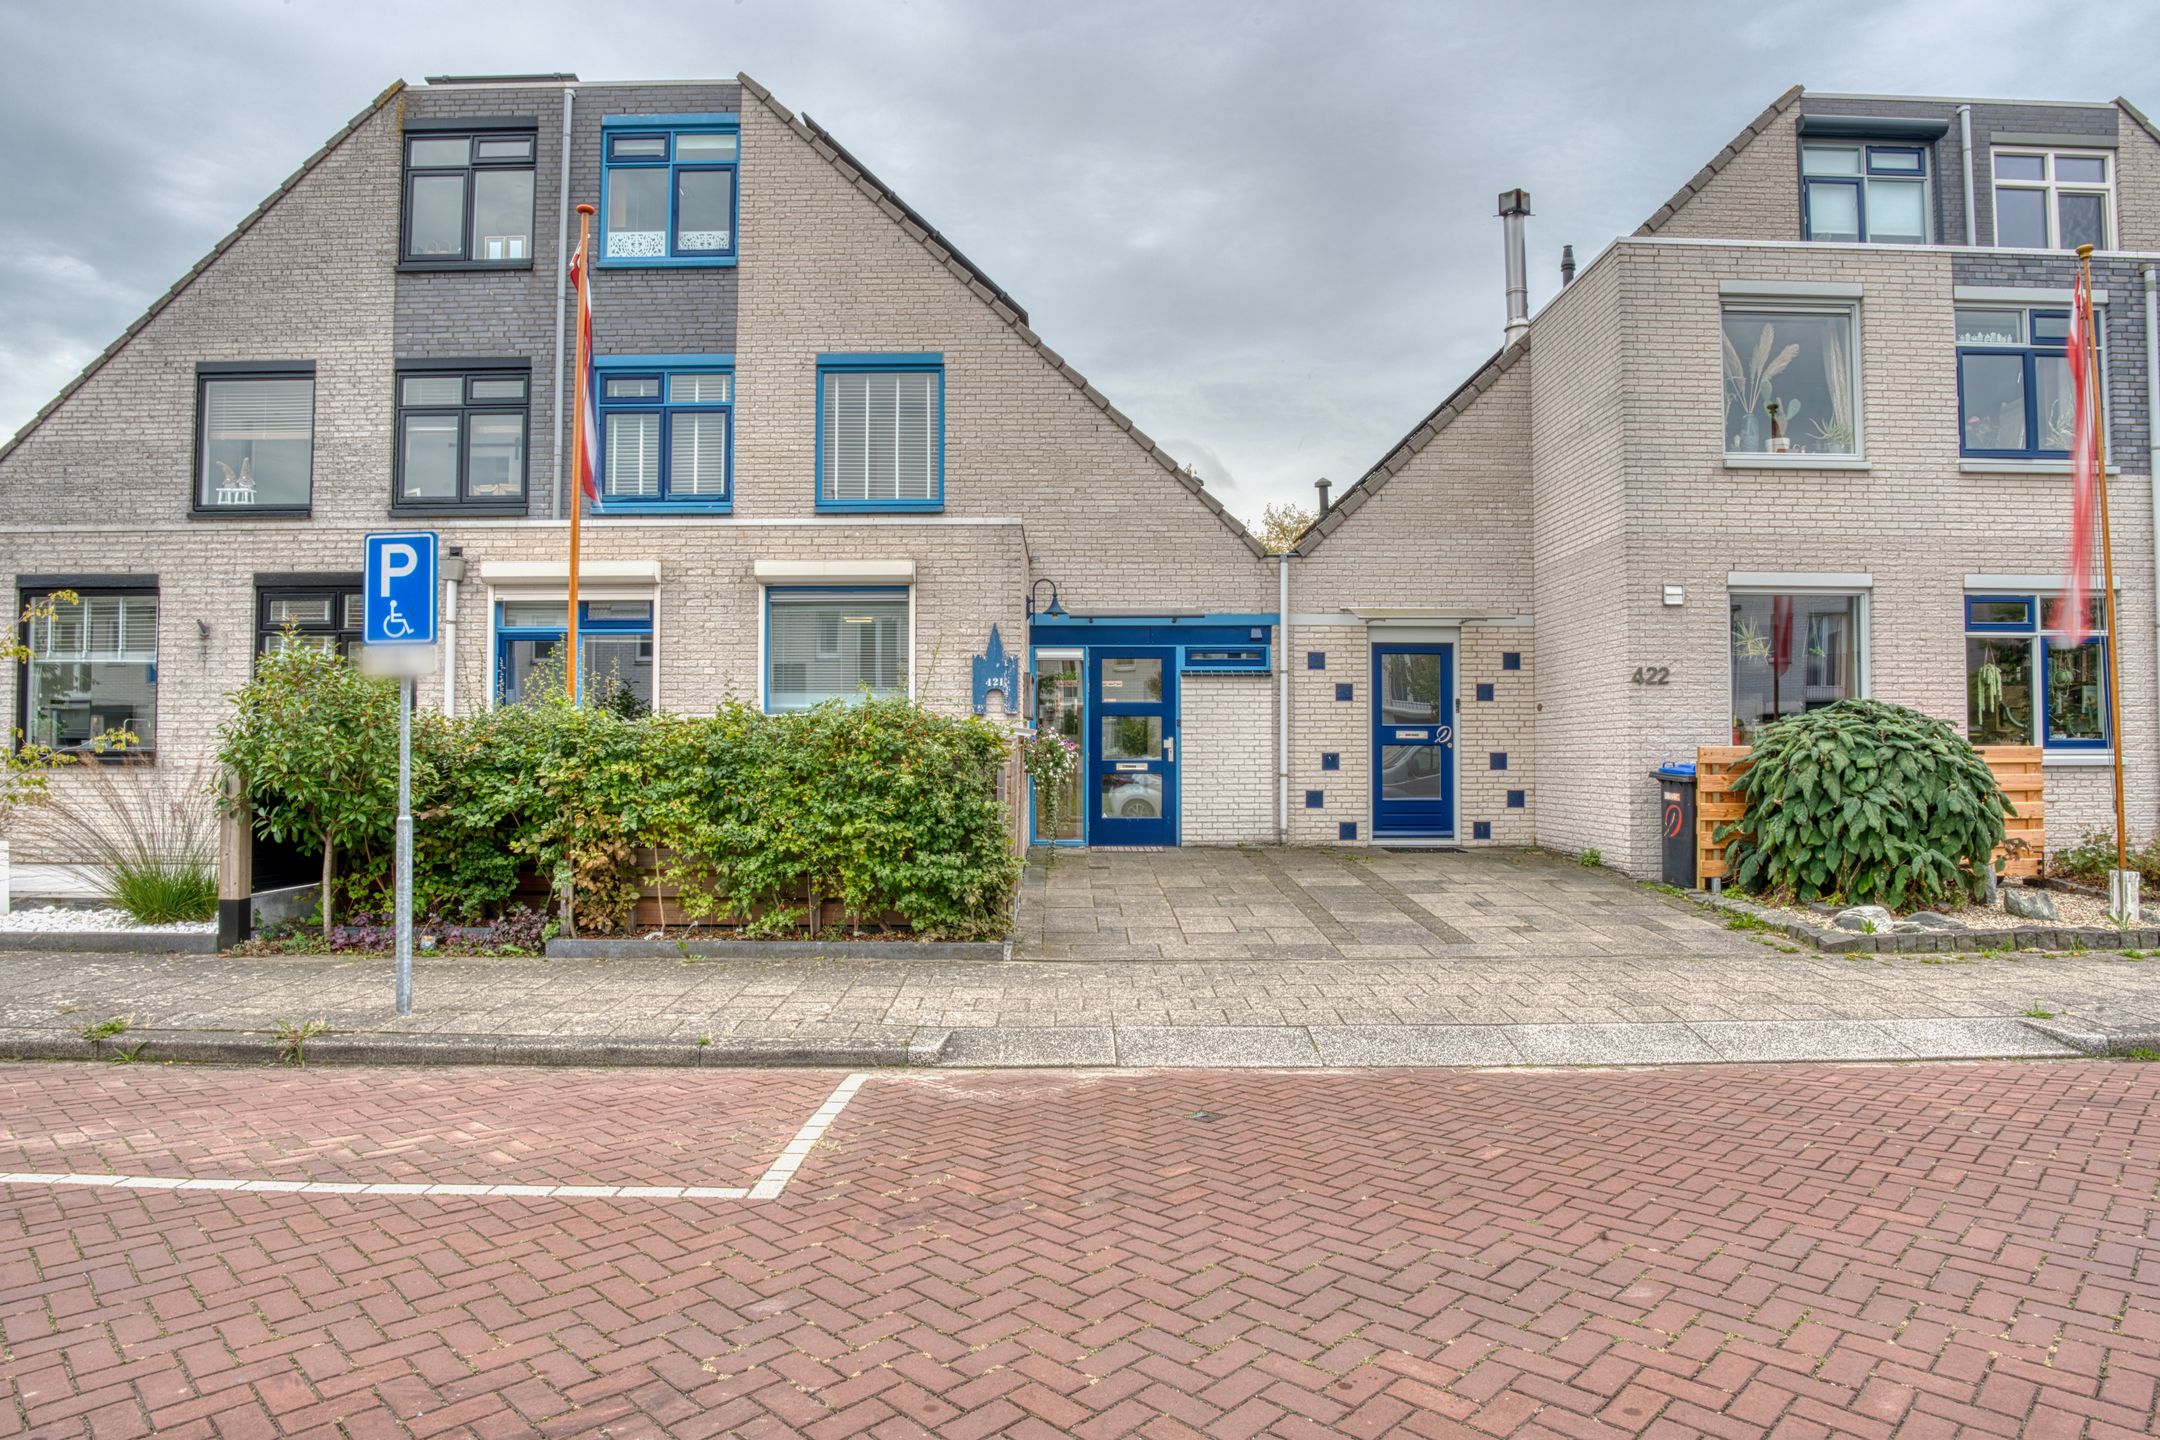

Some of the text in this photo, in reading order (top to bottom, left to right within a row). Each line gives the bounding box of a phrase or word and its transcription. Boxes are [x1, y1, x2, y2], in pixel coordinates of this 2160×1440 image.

[380, 543, 418, 598] P
[985, 677, 1004, 687] 421
[1631, 666, 1669, 686] 422
